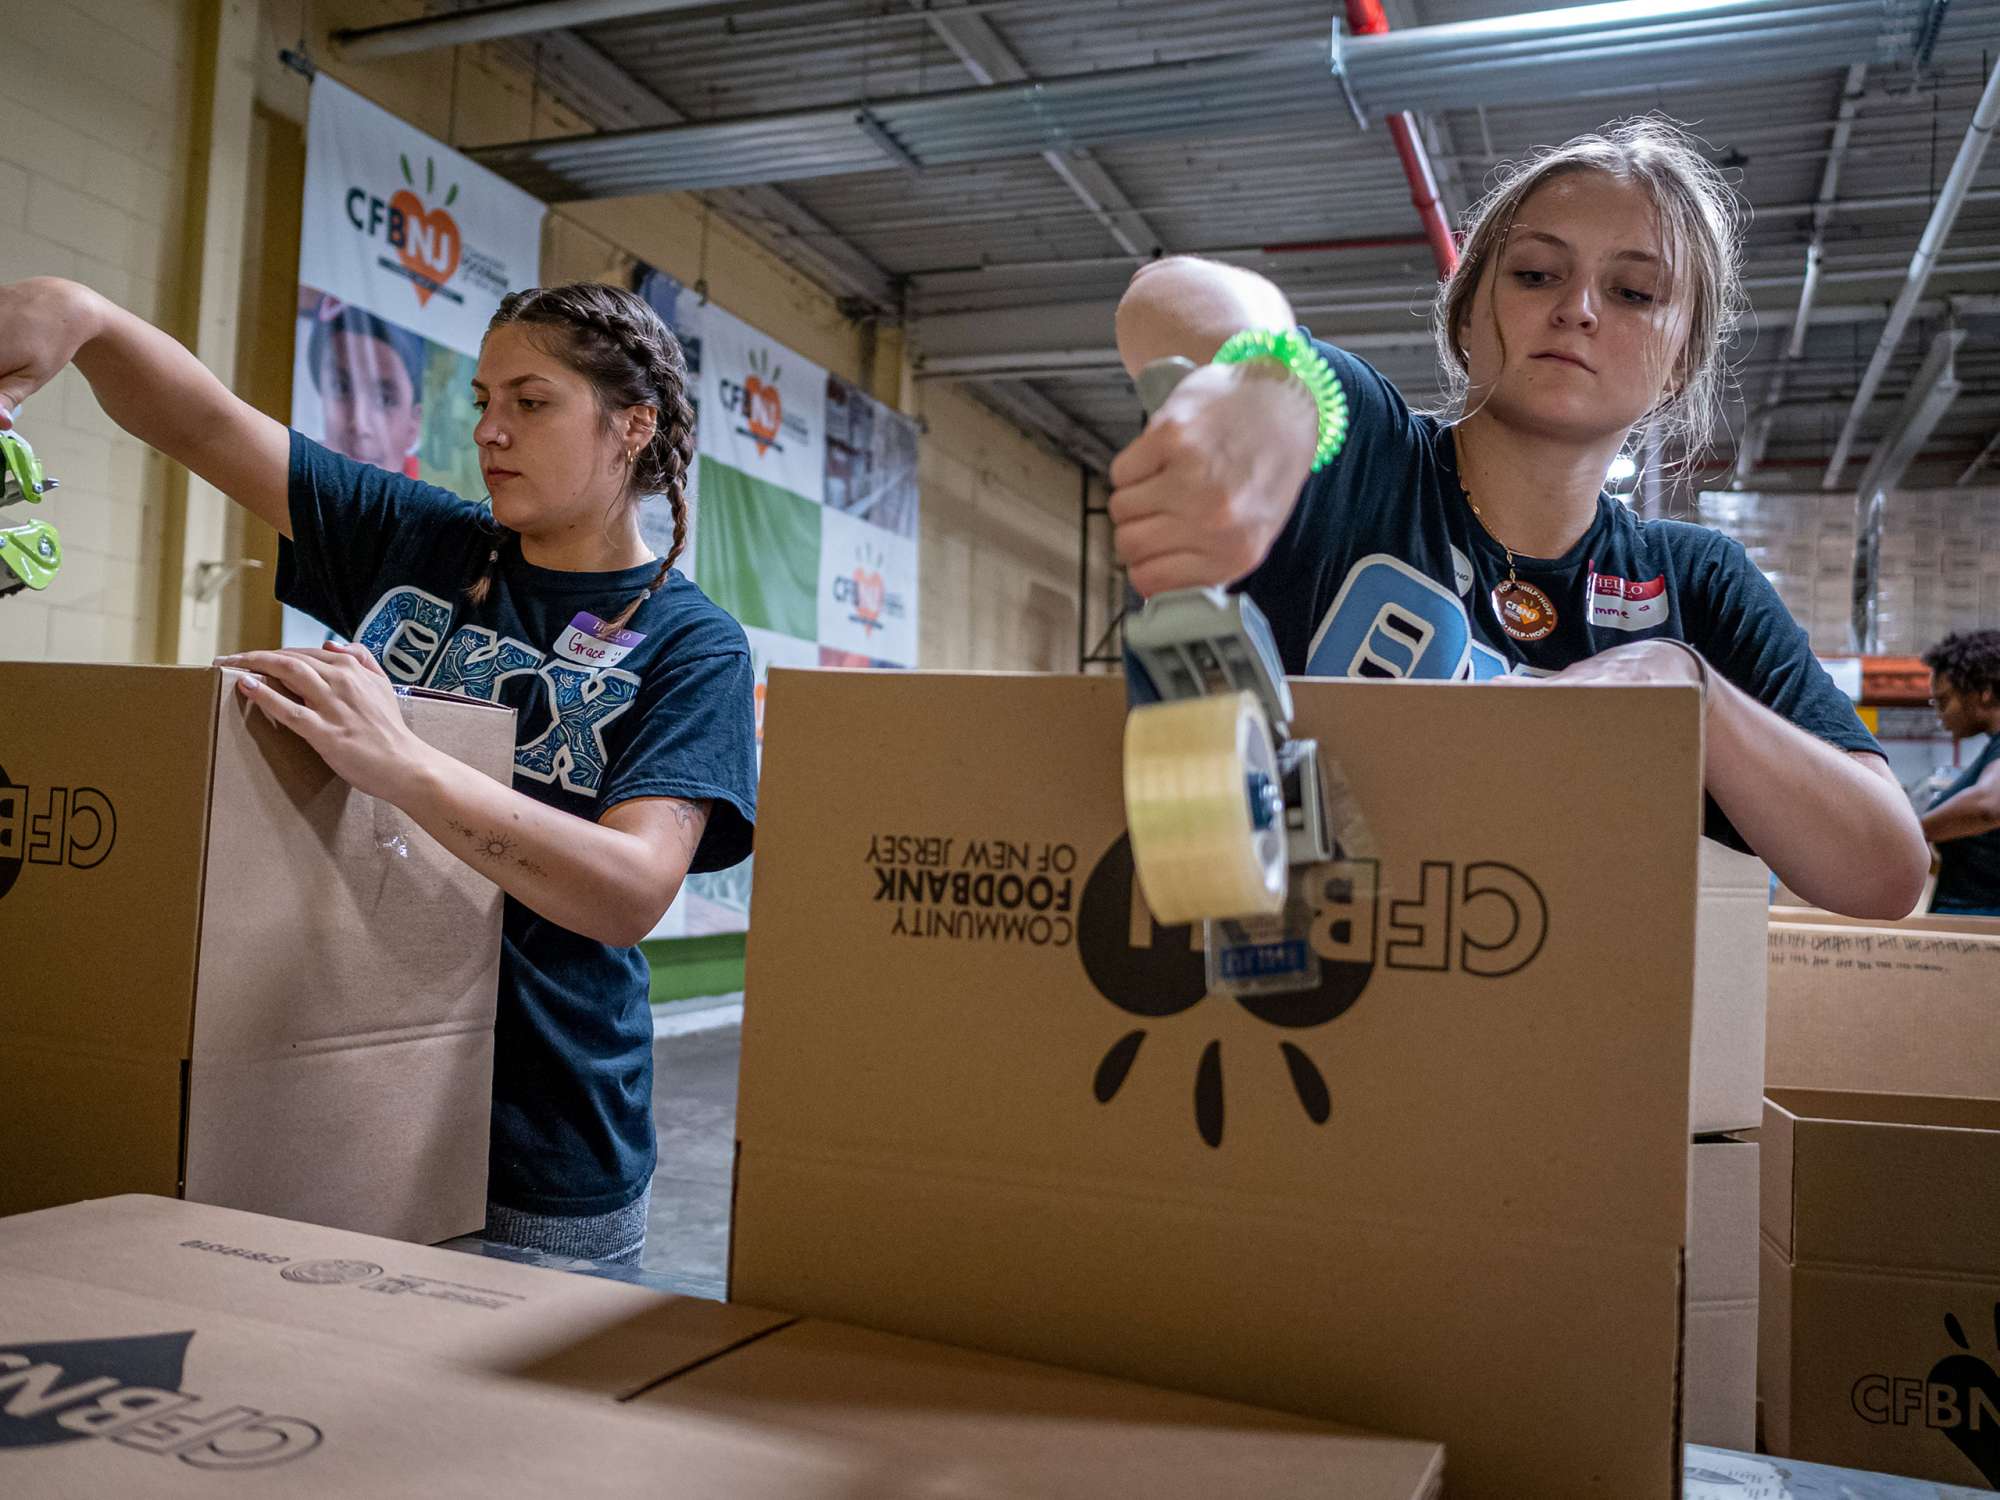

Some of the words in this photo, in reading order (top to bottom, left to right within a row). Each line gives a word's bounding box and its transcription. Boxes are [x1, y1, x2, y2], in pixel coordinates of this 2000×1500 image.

[345, 187, 450, 273] CFBNJ
[568, 632, 606, 659] Grace
[865, 834, 953, 867] JERSEY
[962, 839, 1030, 870] NEW
[1037, 843, 1077, 874] OF
[873, 867, 1071, 912] FOODBANK
[892, 907, 1074, 947] COMMUNITY
